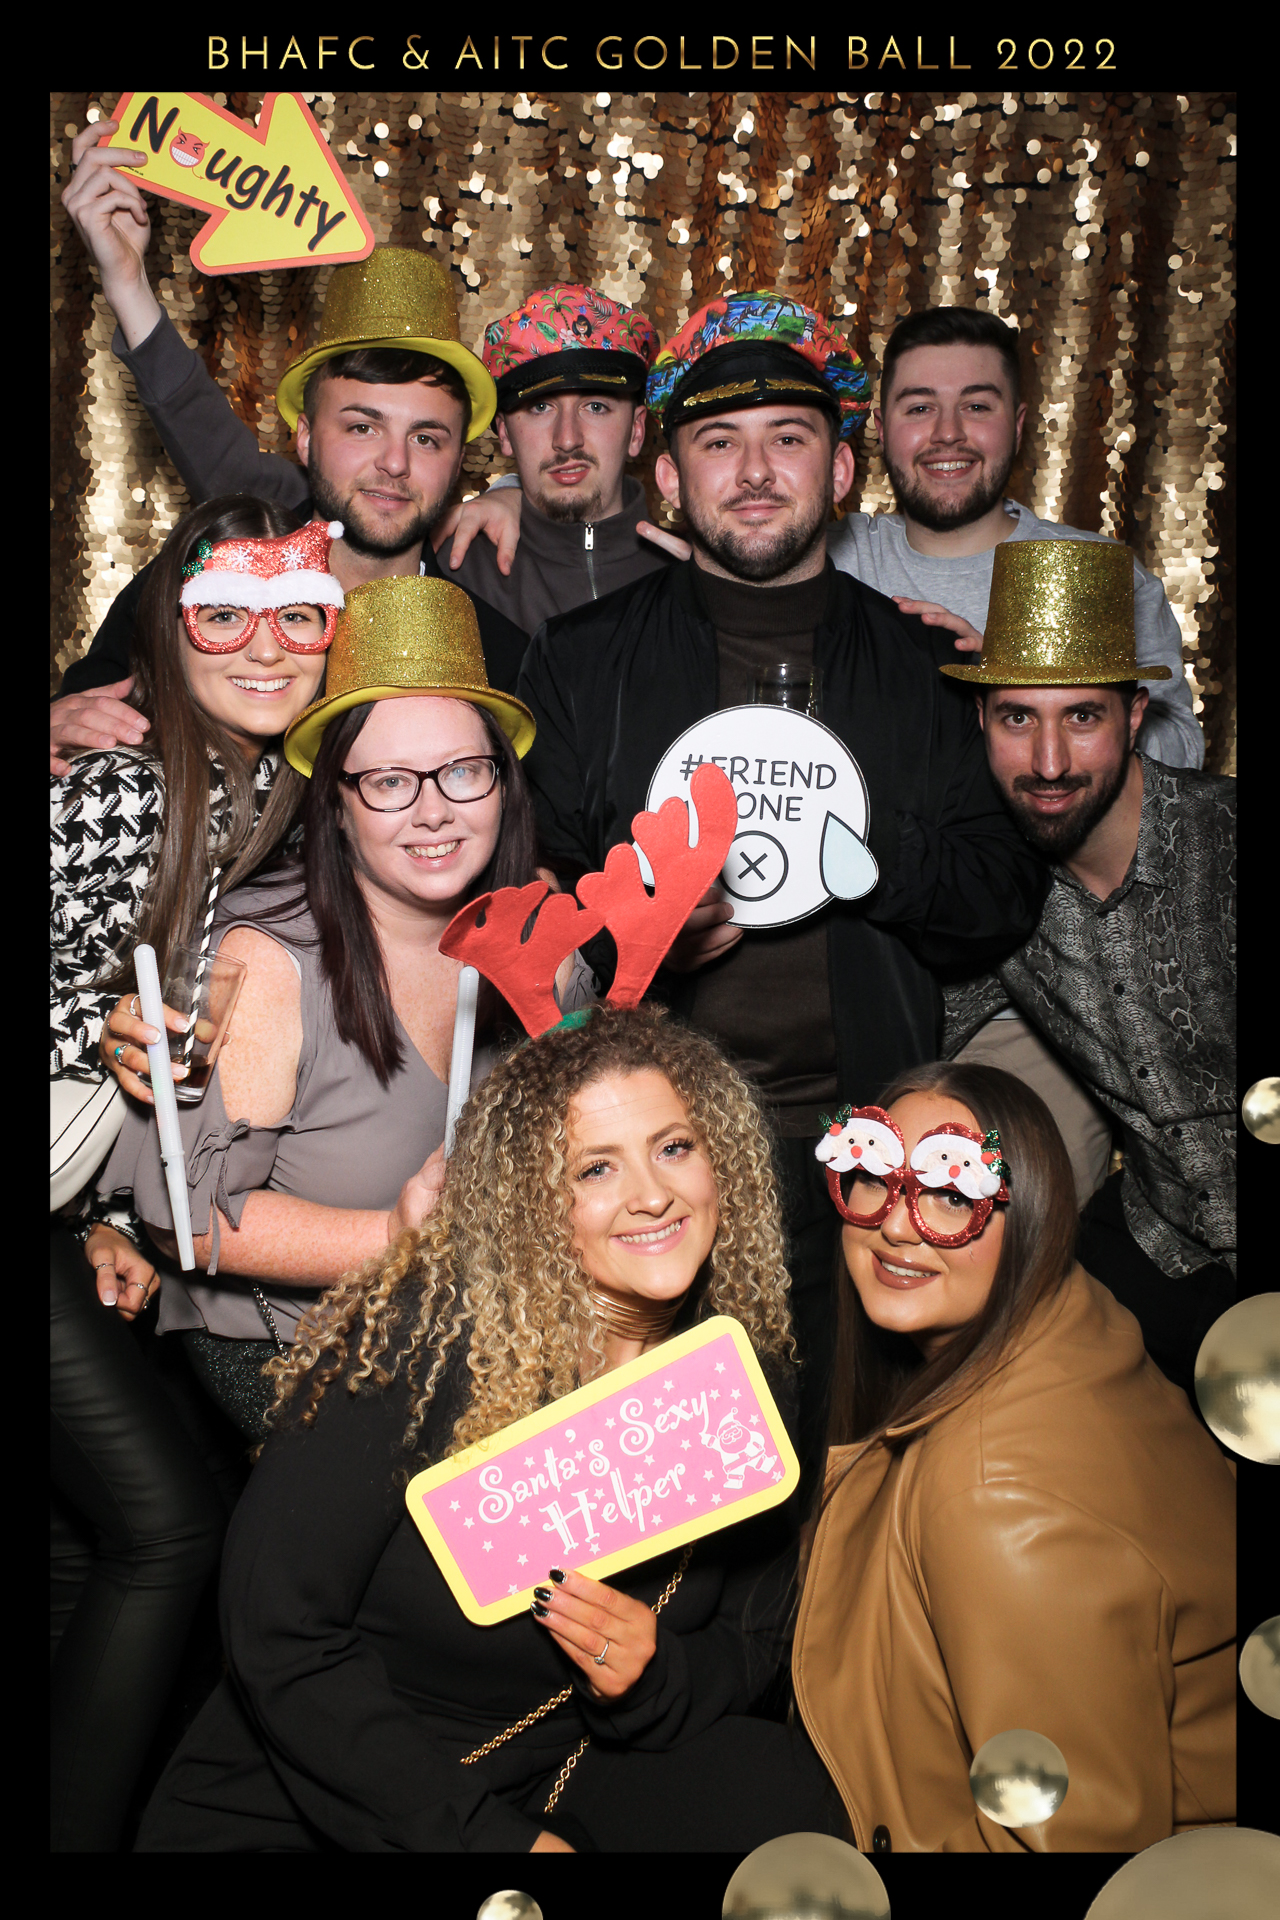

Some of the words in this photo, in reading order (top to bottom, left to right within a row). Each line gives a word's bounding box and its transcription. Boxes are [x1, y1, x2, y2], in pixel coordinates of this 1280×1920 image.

[129, 96, 347, 252] Nughty
[736, 791, 804, 822] ONE
[478, 1428, 611, 1524] Santa's
[619, 1390, 711, 1456] Sexy
[538, 1463, 686, 1556] Helper
